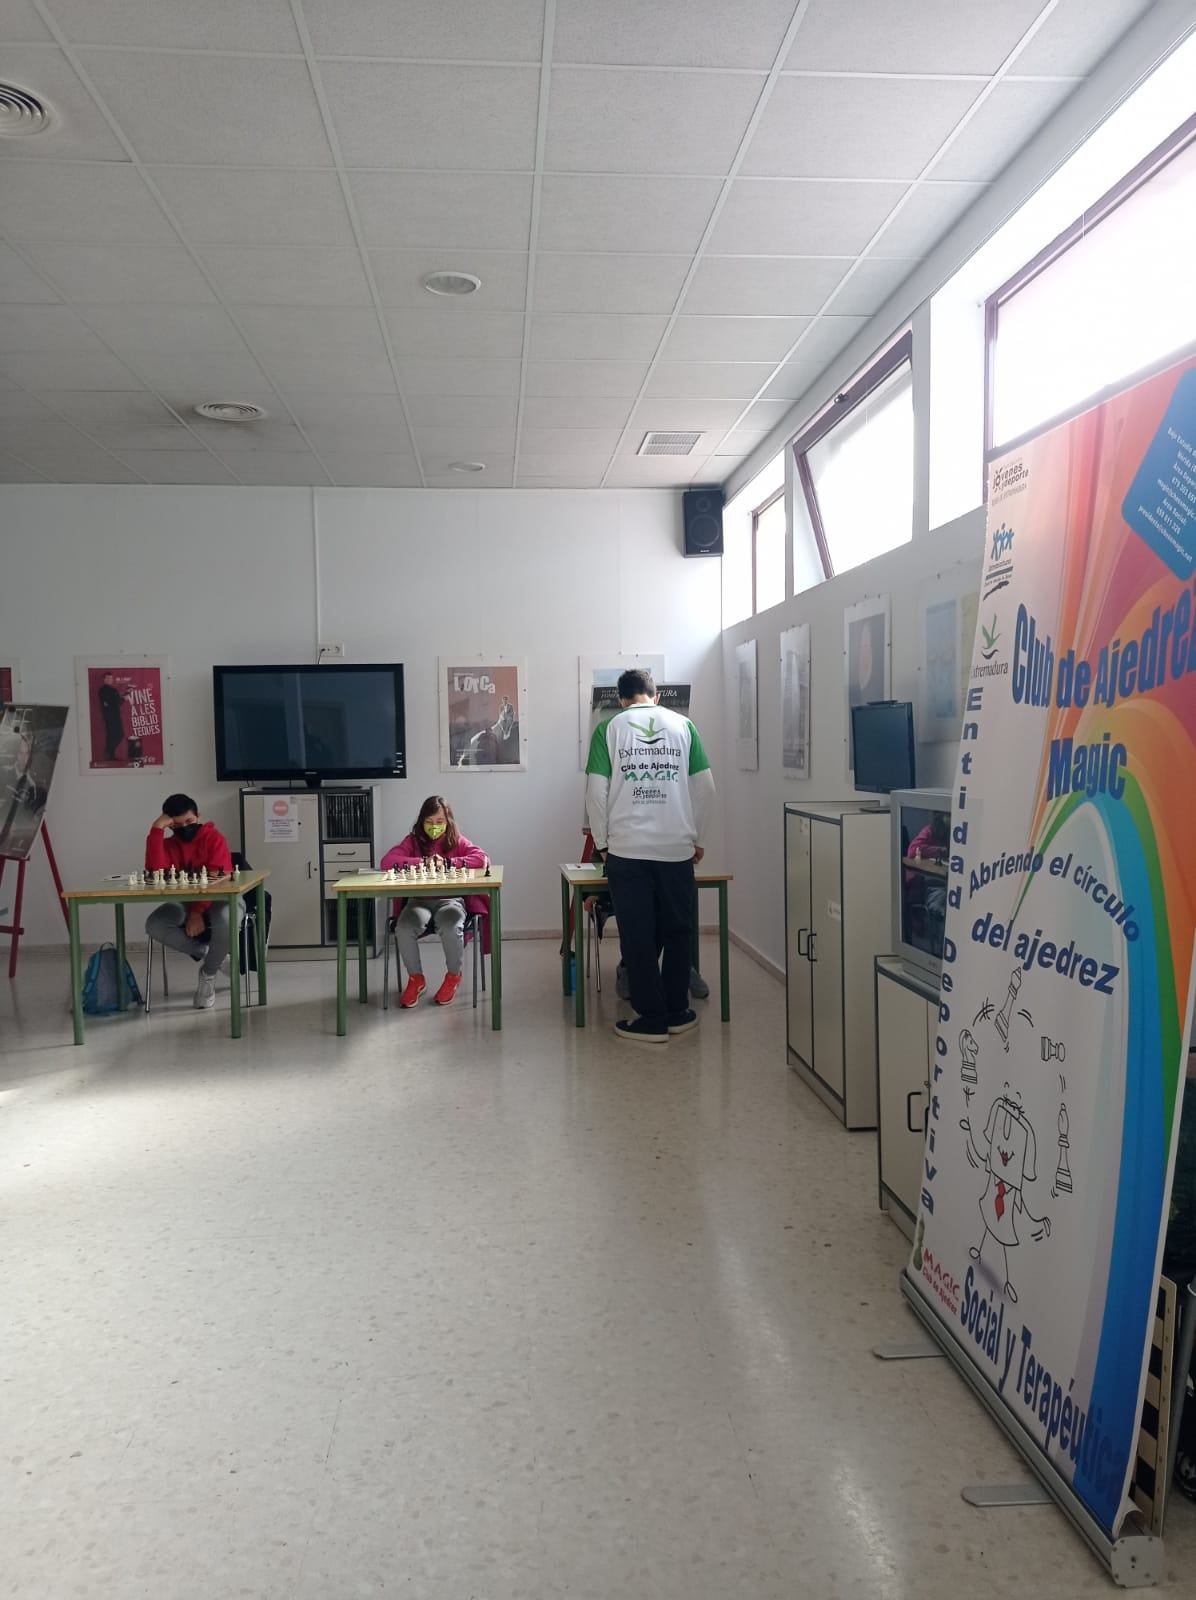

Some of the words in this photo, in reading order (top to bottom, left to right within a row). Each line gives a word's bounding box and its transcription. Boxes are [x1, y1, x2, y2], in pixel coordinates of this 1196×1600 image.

[971, 660, 1008, 679] xtremadura
[1012, 603, 1054, 708] Club
[1055, 649, 1091, 709] de
[131, 714, 158, 727] BIBLIO
[619, 745, 681, 758] Extremadura
[639, 762, 649, 770] de
[1047, 732, 1127, 802] Magic
[969, 846, 1043, 899] Abriendo
[1050, 853, 1073, 877] el
[1073, 865, 1141, 942] círculo
[971, 912, 1014, 952] del
[1014, 929, 1121, 995] ajedrez
[960, 1265, 1005, 1364] Social
[999, 1326, 1016, 1394] y
